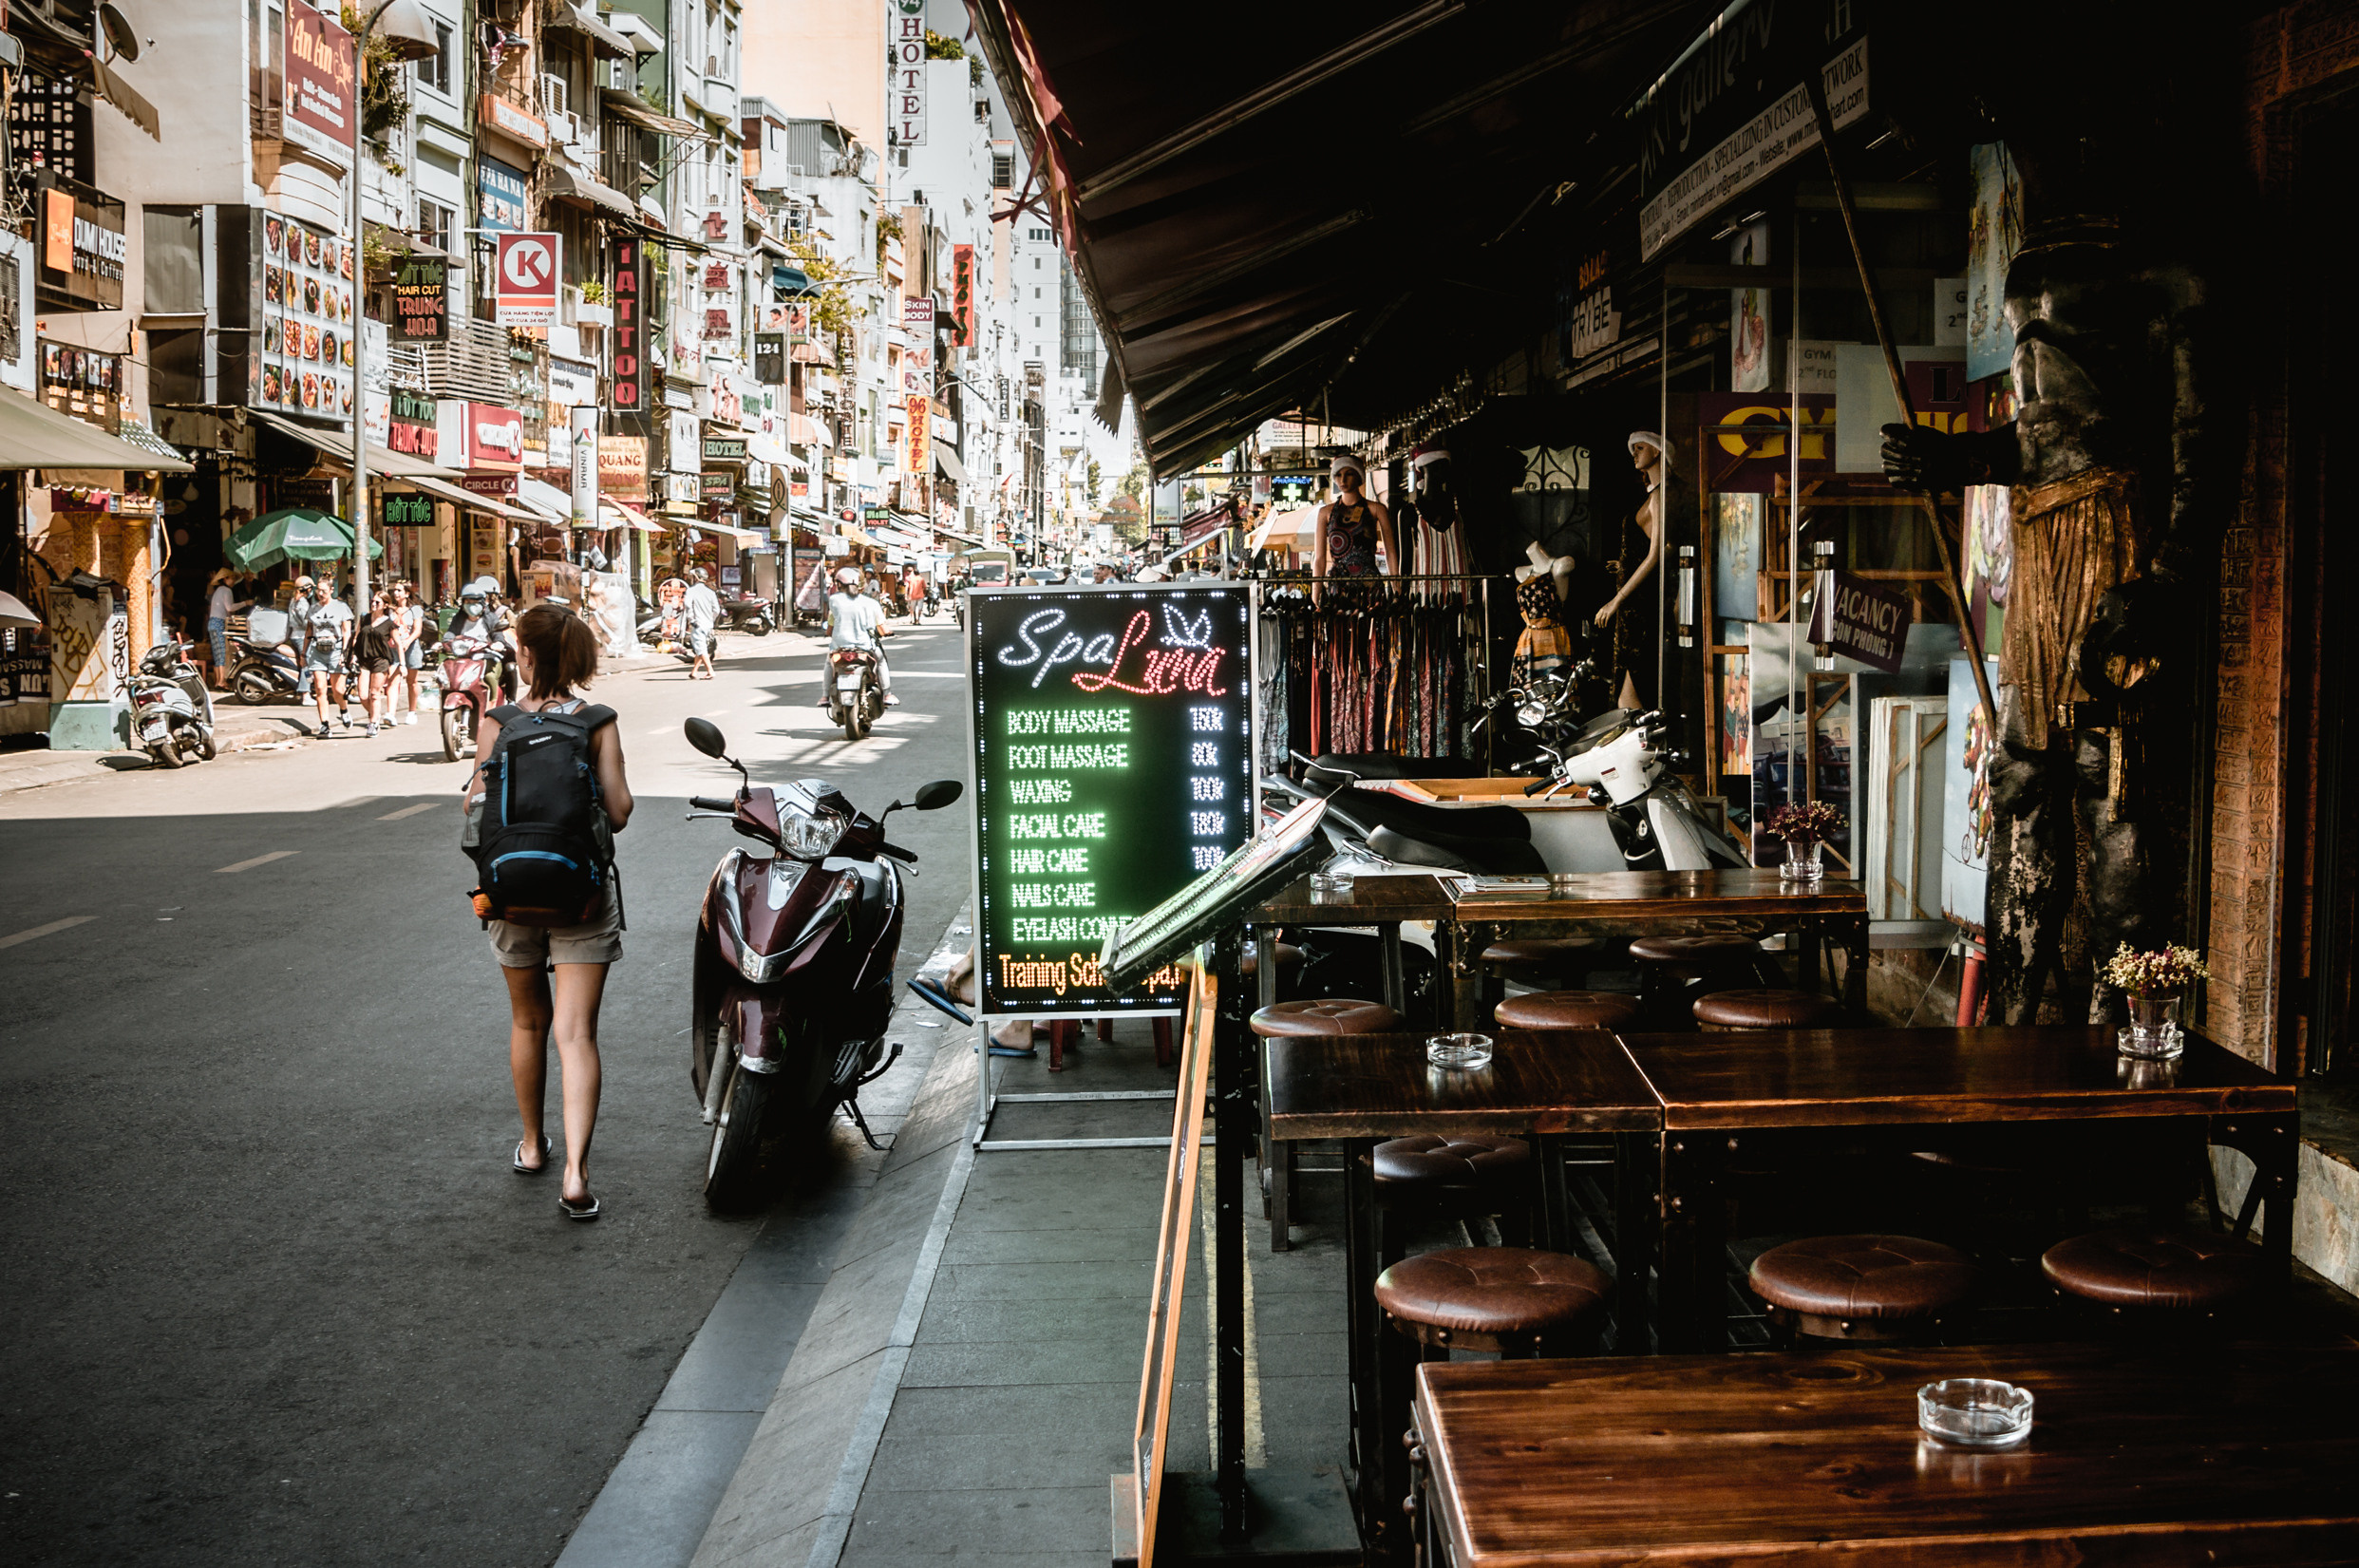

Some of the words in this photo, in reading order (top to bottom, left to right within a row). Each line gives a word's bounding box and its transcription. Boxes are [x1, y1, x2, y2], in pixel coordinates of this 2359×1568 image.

[293, 19, 312, 63] An
[901, 18, 921, 140] HOTEL
[1668, 157, 1710, 208] REPRODUCTION
[1715, 119, 1763, 173] SPECIALIZING
[1765, 111, 1773, 139] IN
[1822, 46, 1863, 96] TWORK
[99, 227, 125, 264] HOUSE
[101, 261, 123, 281] Coffee
[421, 259, 443, 284] TÓC
[518, 251, 546, 284] K
[399, 286, 419, 294] HAIR
[422, 286, 442, 294] CUT
[397, 296, 443, 315] TRUNG
[904, 301, 930, 310] SKIN
[405, 317, 437, 335] HOA
[615, 242, 636, 405] TATTOO
[1572, 299, 1610, 343] TRIBE
[757, 344, 779, 354] 124
[1804, 349, 1832, 360] GYM
[909, 397, 926, 414] 96
[706, 441, 745, 456] HOTEL
[911, 415, 924, 469] HOTEL
[599, 454, 641, 468] QUANG
[465, 481, 500, 490] CIRCLE
[705, 477, 727, 485] SPA
[409, 497, 431, 522] TÓC
[998, 608, 1114, 689] Spa
[0, 658, 44, 673] MASSA
[1008, 709, 1051, 735] BODY
[1054, 708, 1131, 734] MASSAGE
[1009, 745, 1047, 770] FOOT
[1050, 743, 1129, 769] MASSAGE
[1010, 779, 1072, 804] WAXING
[1010, 813, 1063, 840] FACIAL
[1064, 812, 1106, 839] CARE
[1010, 849, 1046, 875] HAIR
[1047, 847, 1089, 873] CARE
[1011, 883, 1051, 908] NAILS
[1053, 882, 1096, 907] CARE
[1012, 917, 1078, 942] EYELASH
[999, 953, 1066, 996] Training
[1069, 952, 1104, 987] Sch
